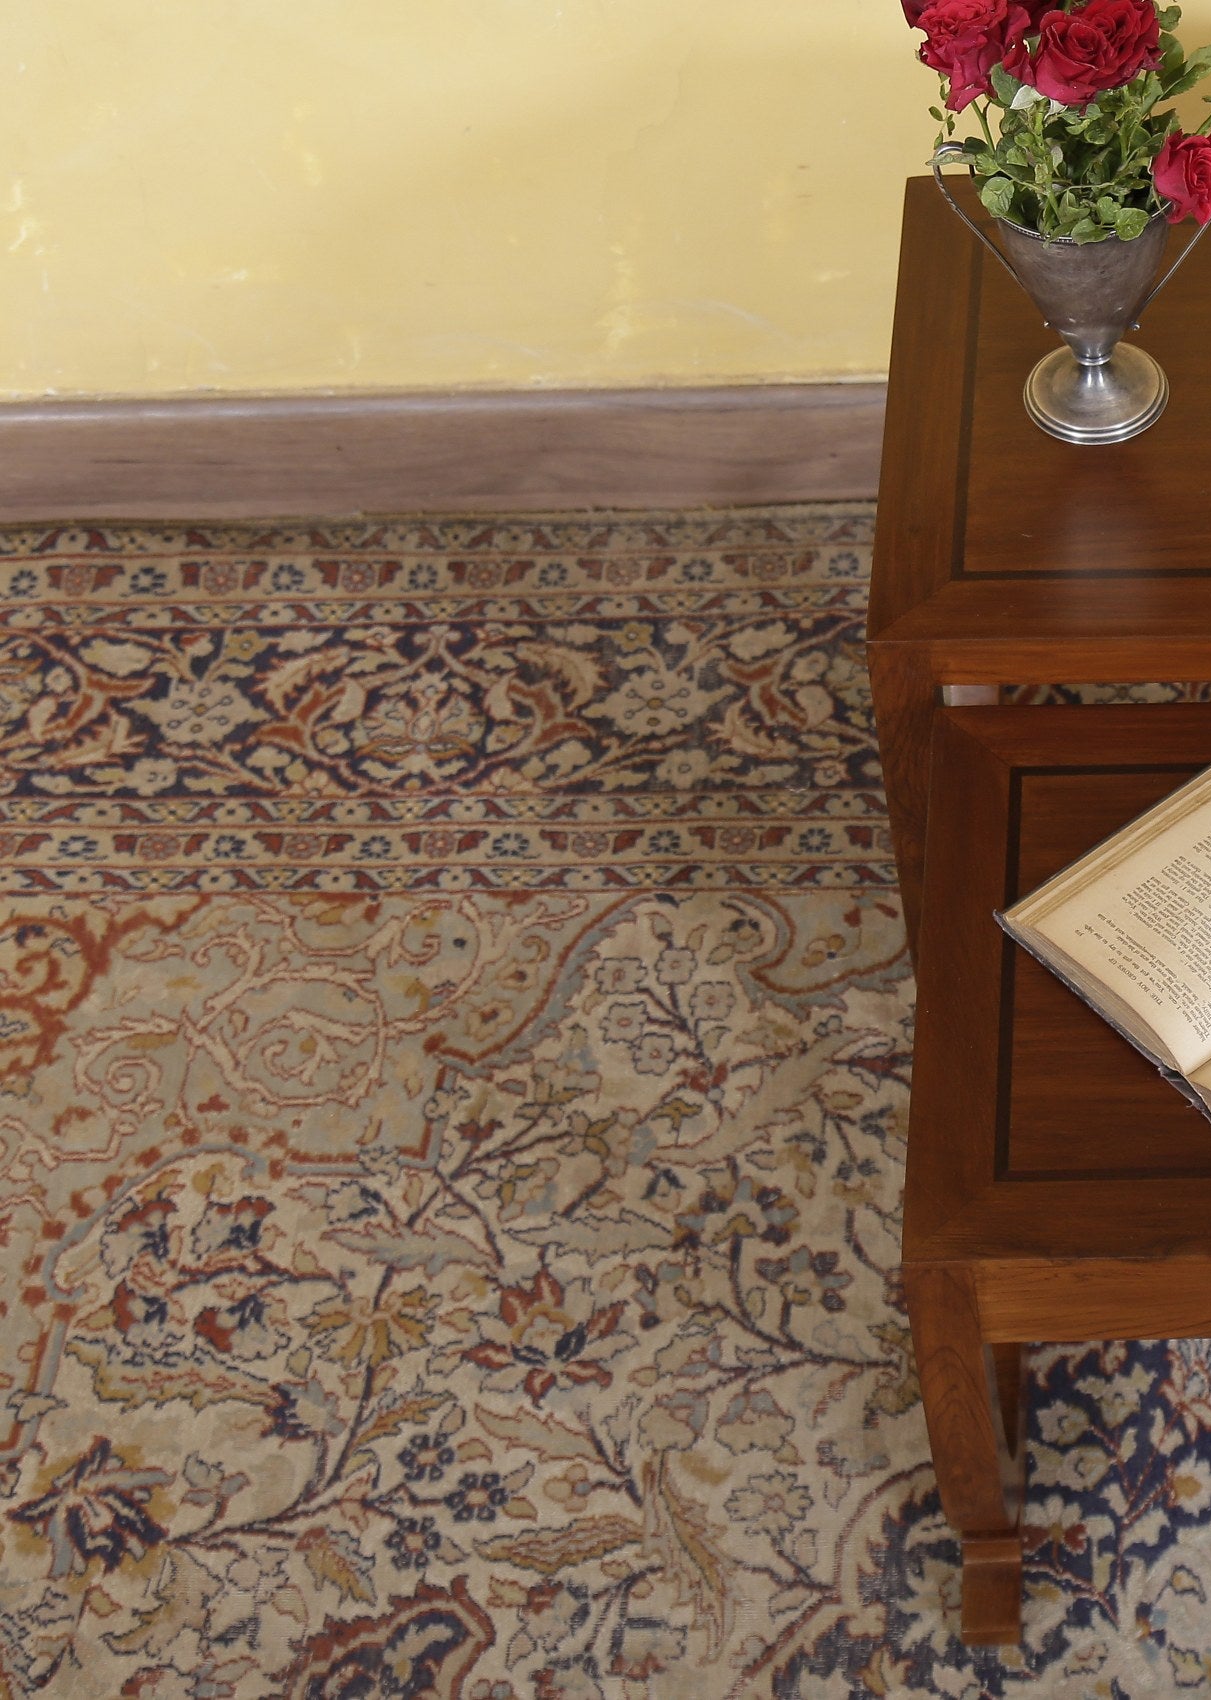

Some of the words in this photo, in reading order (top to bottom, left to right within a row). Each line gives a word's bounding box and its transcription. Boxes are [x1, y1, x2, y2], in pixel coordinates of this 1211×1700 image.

[1116, 961, 1137, 982] GROWS
[1136, 979, 1150, 993] BOY
[1148, 991, 1164, 1006] THE
